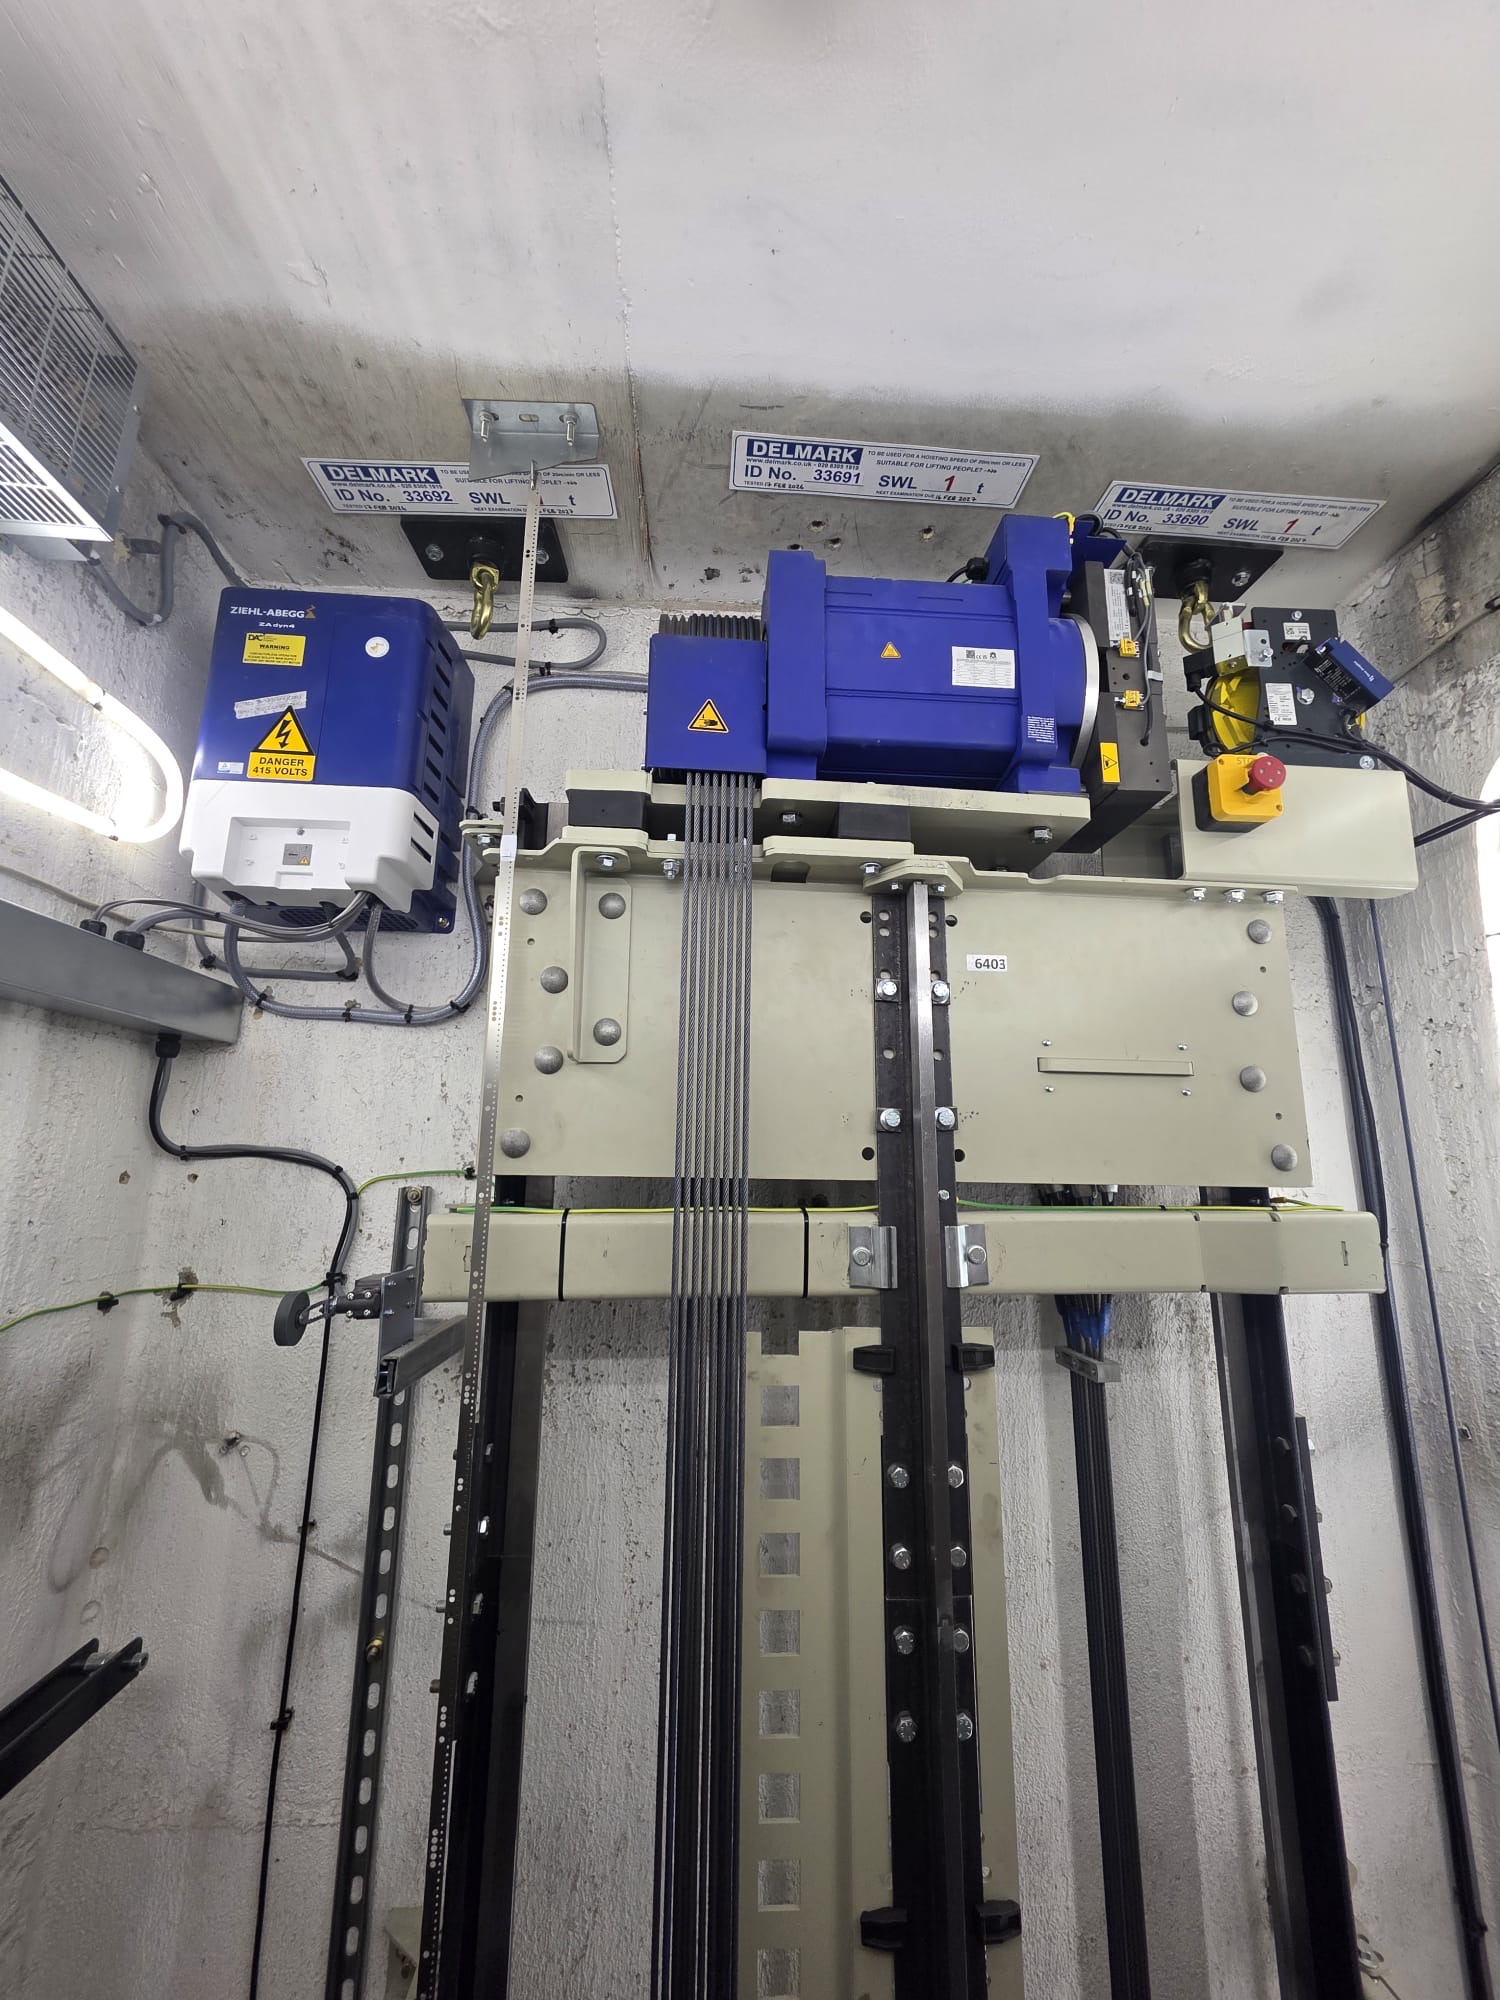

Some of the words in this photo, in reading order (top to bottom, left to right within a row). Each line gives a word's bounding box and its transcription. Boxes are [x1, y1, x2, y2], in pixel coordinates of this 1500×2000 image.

[752, 441, 859, 463] DELMARK
[746, 458, 812, 467] www.delmark.co.uk
[876, 459, 908, 467] SUITABLE
[925, 463, 952, 471] LIFTING
[327, 465, 434, 483] DELMARK
[744, 465, 762, 478] ID
[768, 466, 796, 481] No.
[813, 469, 861, 484] 33691
[878, 475, 918, 490] SWL
[944, 475, 955, 492] 1
[977, 482, 984, 494] t
[334, 489, 354, 501] ID
[358, 489, 390, 502] No.
[403, 490, 453, 502] 33692
[469, 492, 511, 504] SWL
[568, 495, 576, 506] t
[1121, 490, 1220, 508] DELMARK
[1104, 509, 1122, 520] ID
[1124, 510, 1149, 523] No.
[1162, 513, 1209, 525] 33690
[1223, 518, 1260, 531] SWL
[1284, 518, 1299, 533] 1
[1311, 525, 1322, 536] t
[230, 606, 305, 618] ZIEHL-ABEGG
[259, 757, 304, 767] DANGER
[252, 766, 271, 774] 415
[274, 767, 308, 777] VOLTS
[975, 958, 1006, 970] 6403
